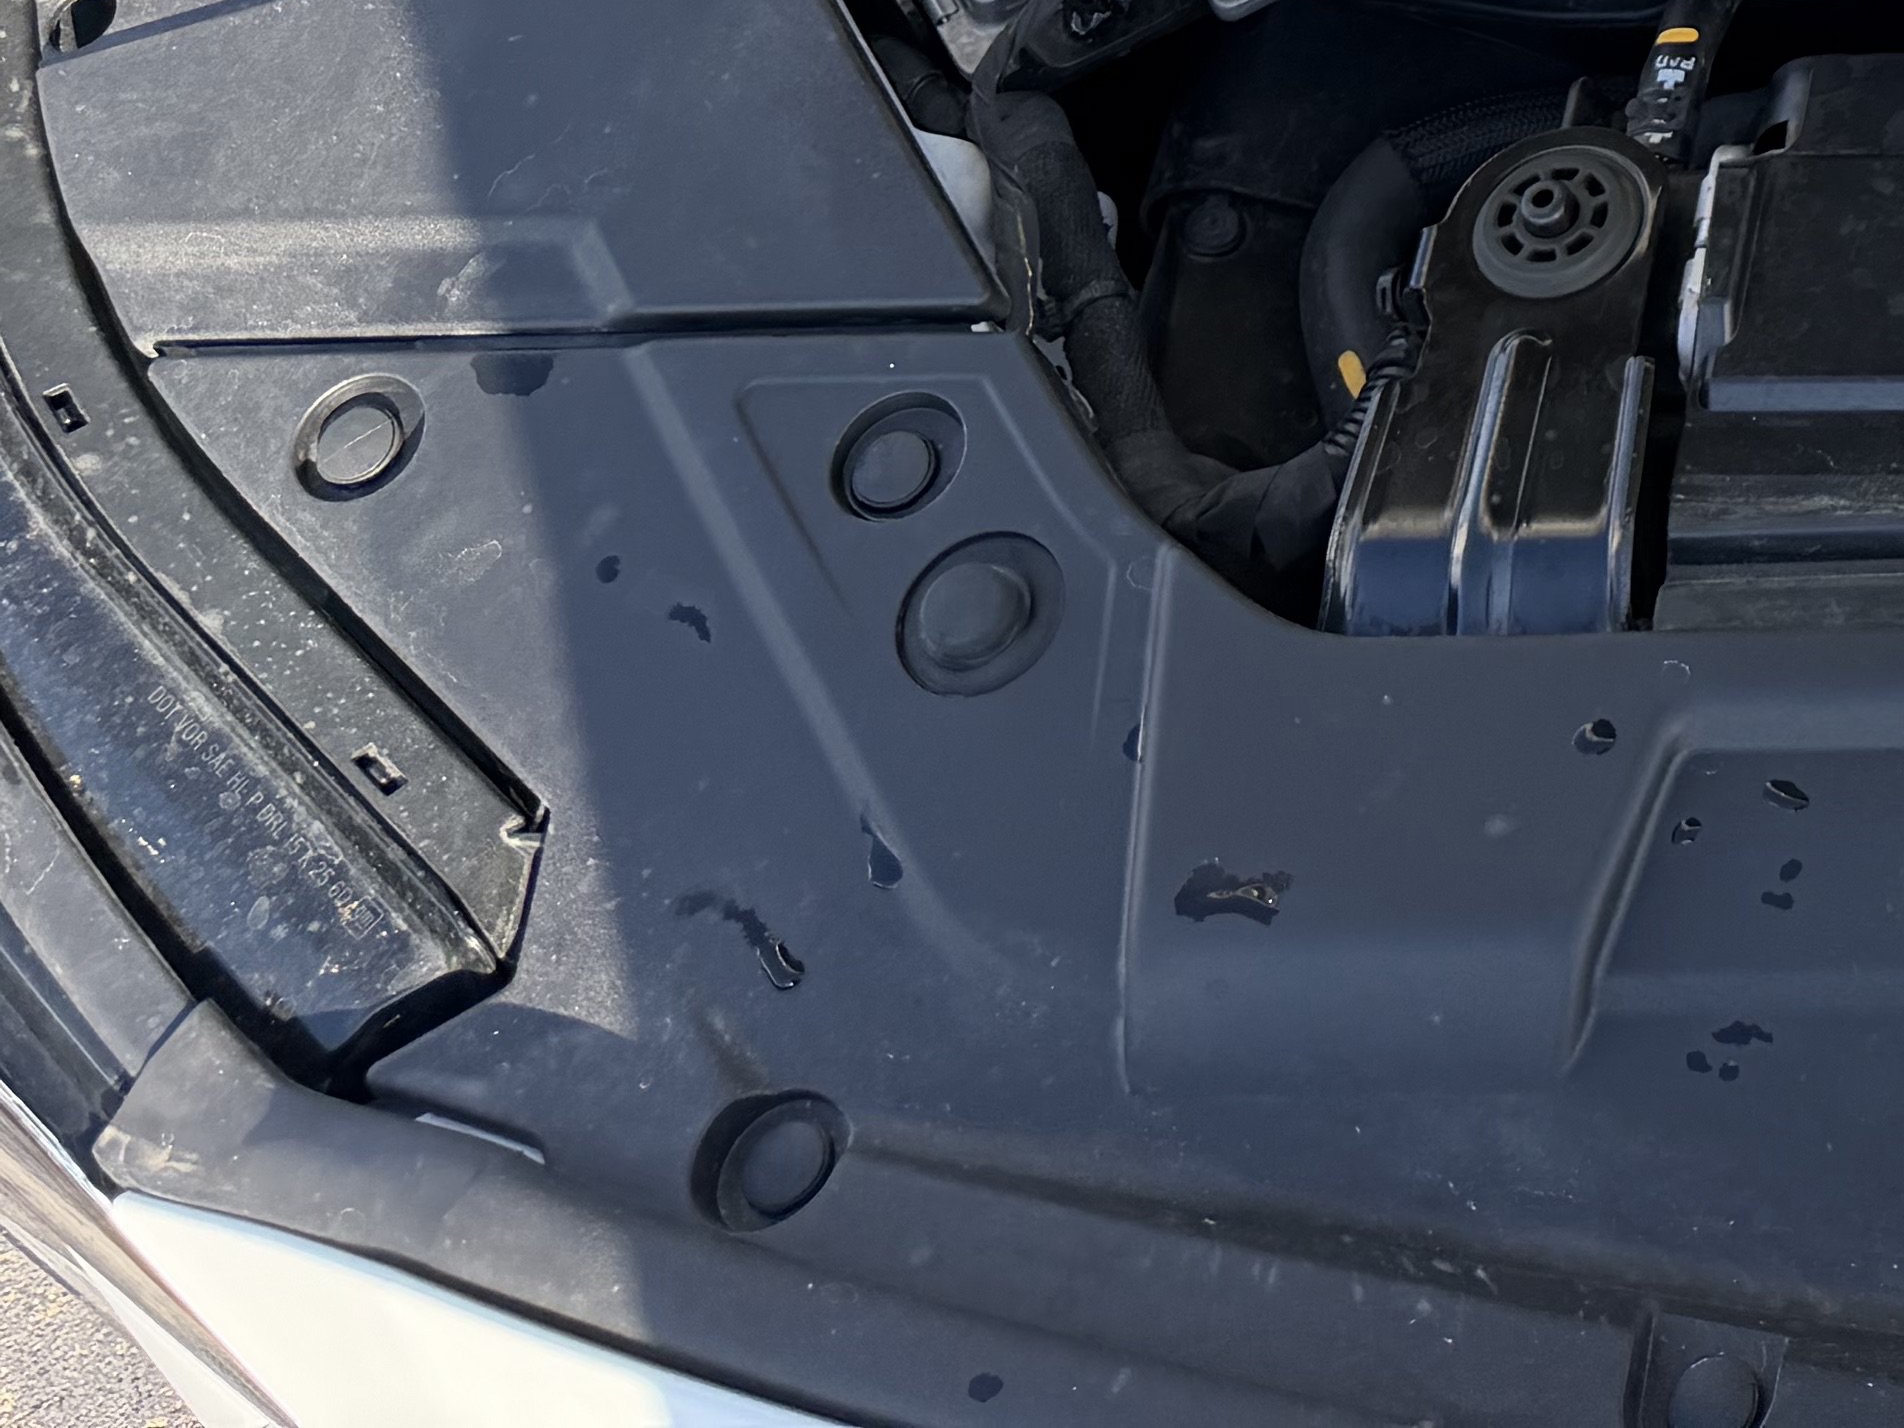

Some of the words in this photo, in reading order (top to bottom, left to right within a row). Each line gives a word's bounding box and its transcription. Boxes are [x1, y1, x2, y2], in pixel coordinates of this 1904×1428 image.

[147, 685, 184, 720] DOT
[175, 714, 208, 751] VOR
[201, 744, 235, 778] SAE
[226, 771, 250, 795] HL
[245, 791, 264, 807] P
[256, 803, 288, 840] DRL
